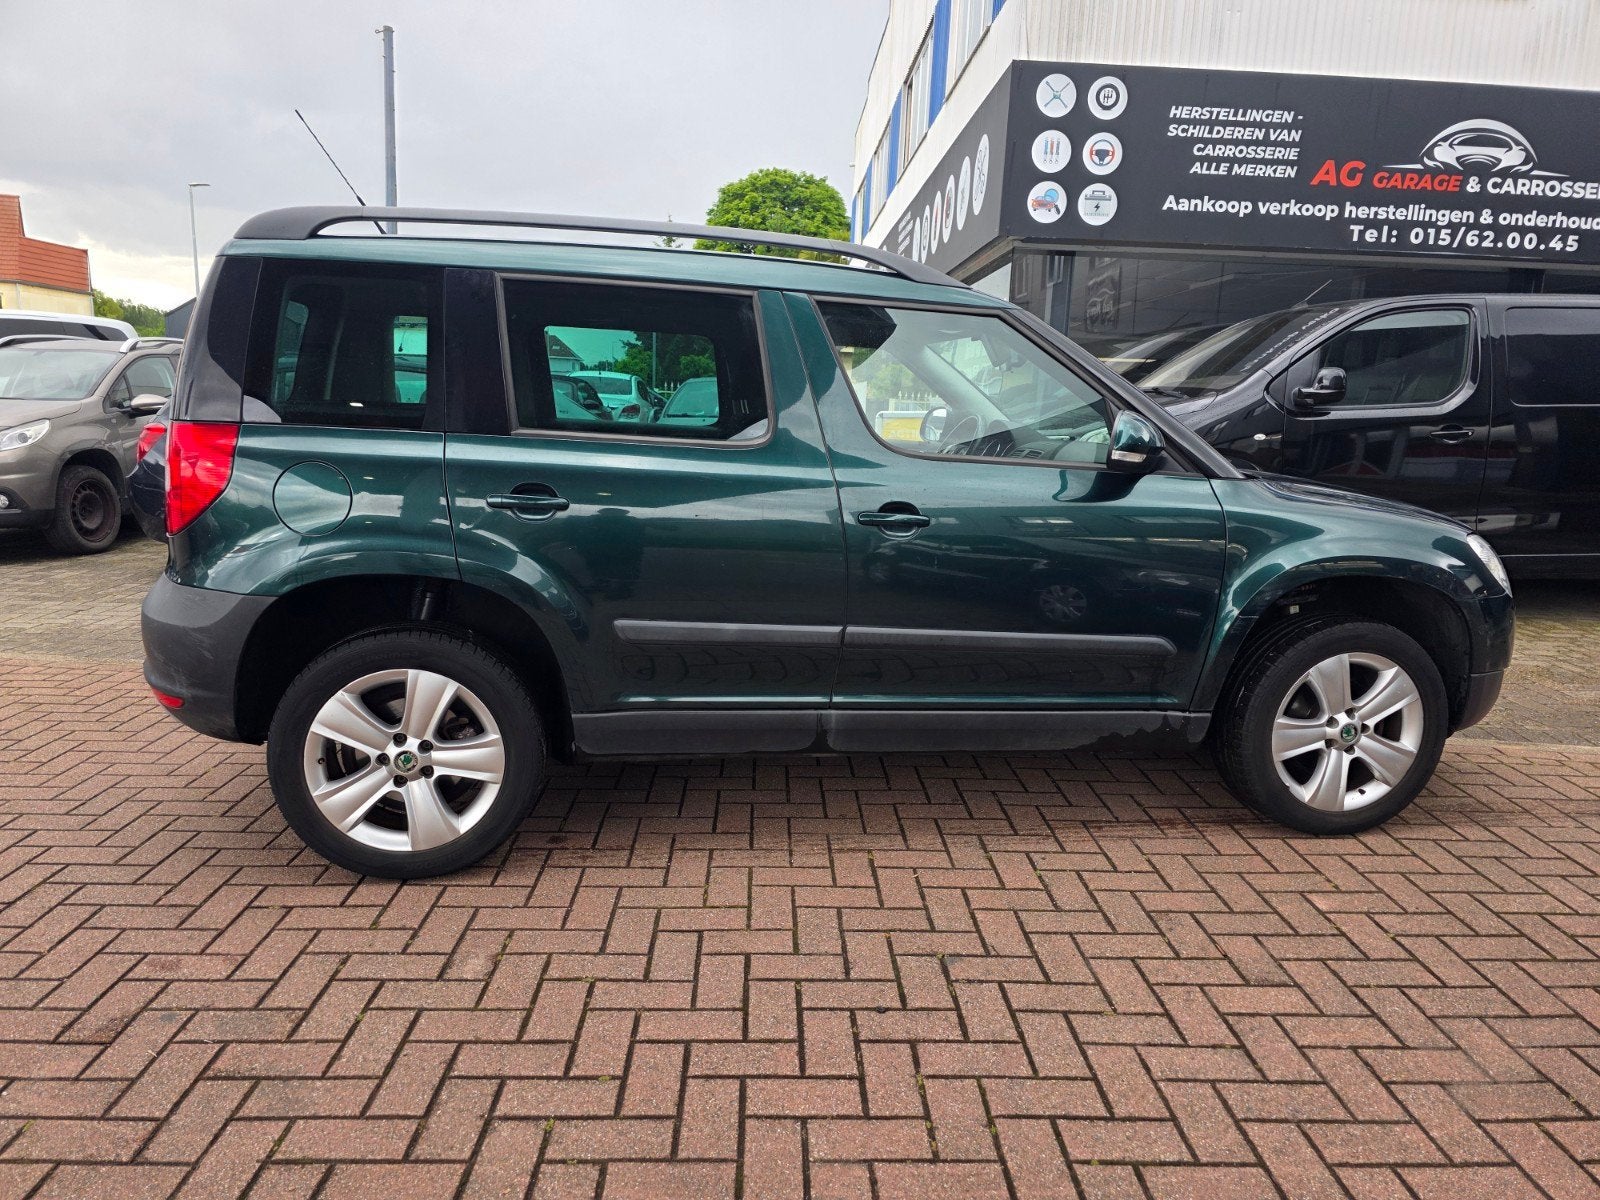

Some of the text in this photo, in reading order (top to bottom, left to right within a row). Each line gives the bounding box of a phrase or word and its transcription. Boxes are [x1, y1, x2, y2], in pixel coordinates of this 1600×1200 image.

[1169, 105, 1294, 123] HERSTELLINGEN
[1167, 124, 1302, 142] SCHILDEREN VAN
[1193, 144, 1300, 160] CARROSSERIE
[1190, 162, 1298, 178] ALLE MERKEN
[1310, 159, 1367, 188] AG
[1372, 172, 1463, 192] GARAGE
[1466, 176, 1481, 193] &
[1162, 194, 1253, 218] Aankoop
[1257, 199, 1339, 221] verkoop
[1344, 202, 1475, 227] herstellingen
[1480, 209, 1494, 225] &
[1350, 225, 1580, 252] Tel: 015/62.00.45
